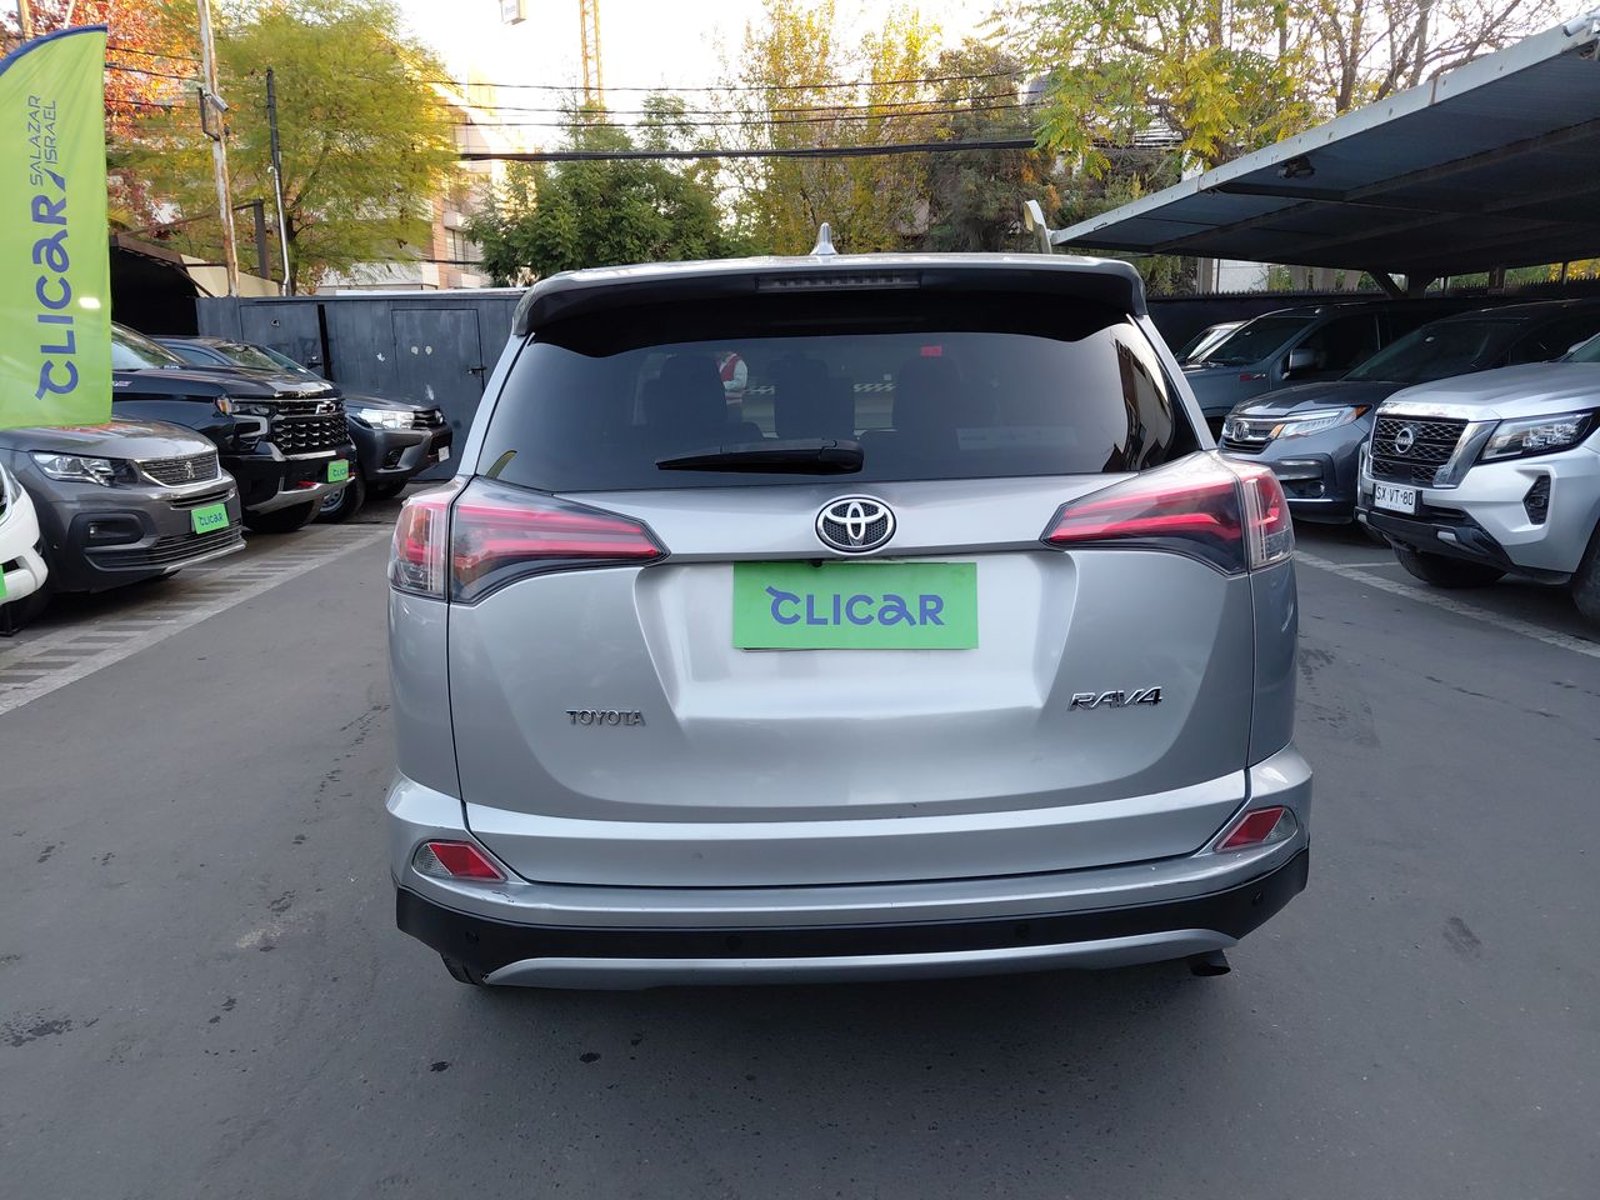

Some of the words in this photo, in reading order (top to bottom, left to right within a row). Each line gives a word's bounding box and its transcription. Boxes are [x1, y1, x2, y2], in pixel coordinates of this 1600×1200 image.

[28, 95, 43, 186] SALAZAR
[43, 100, 58, 165] ISRAEL
[566, 709, 647, 726] TOYOTA
[1067, 686, 1163, 711] RAV4
